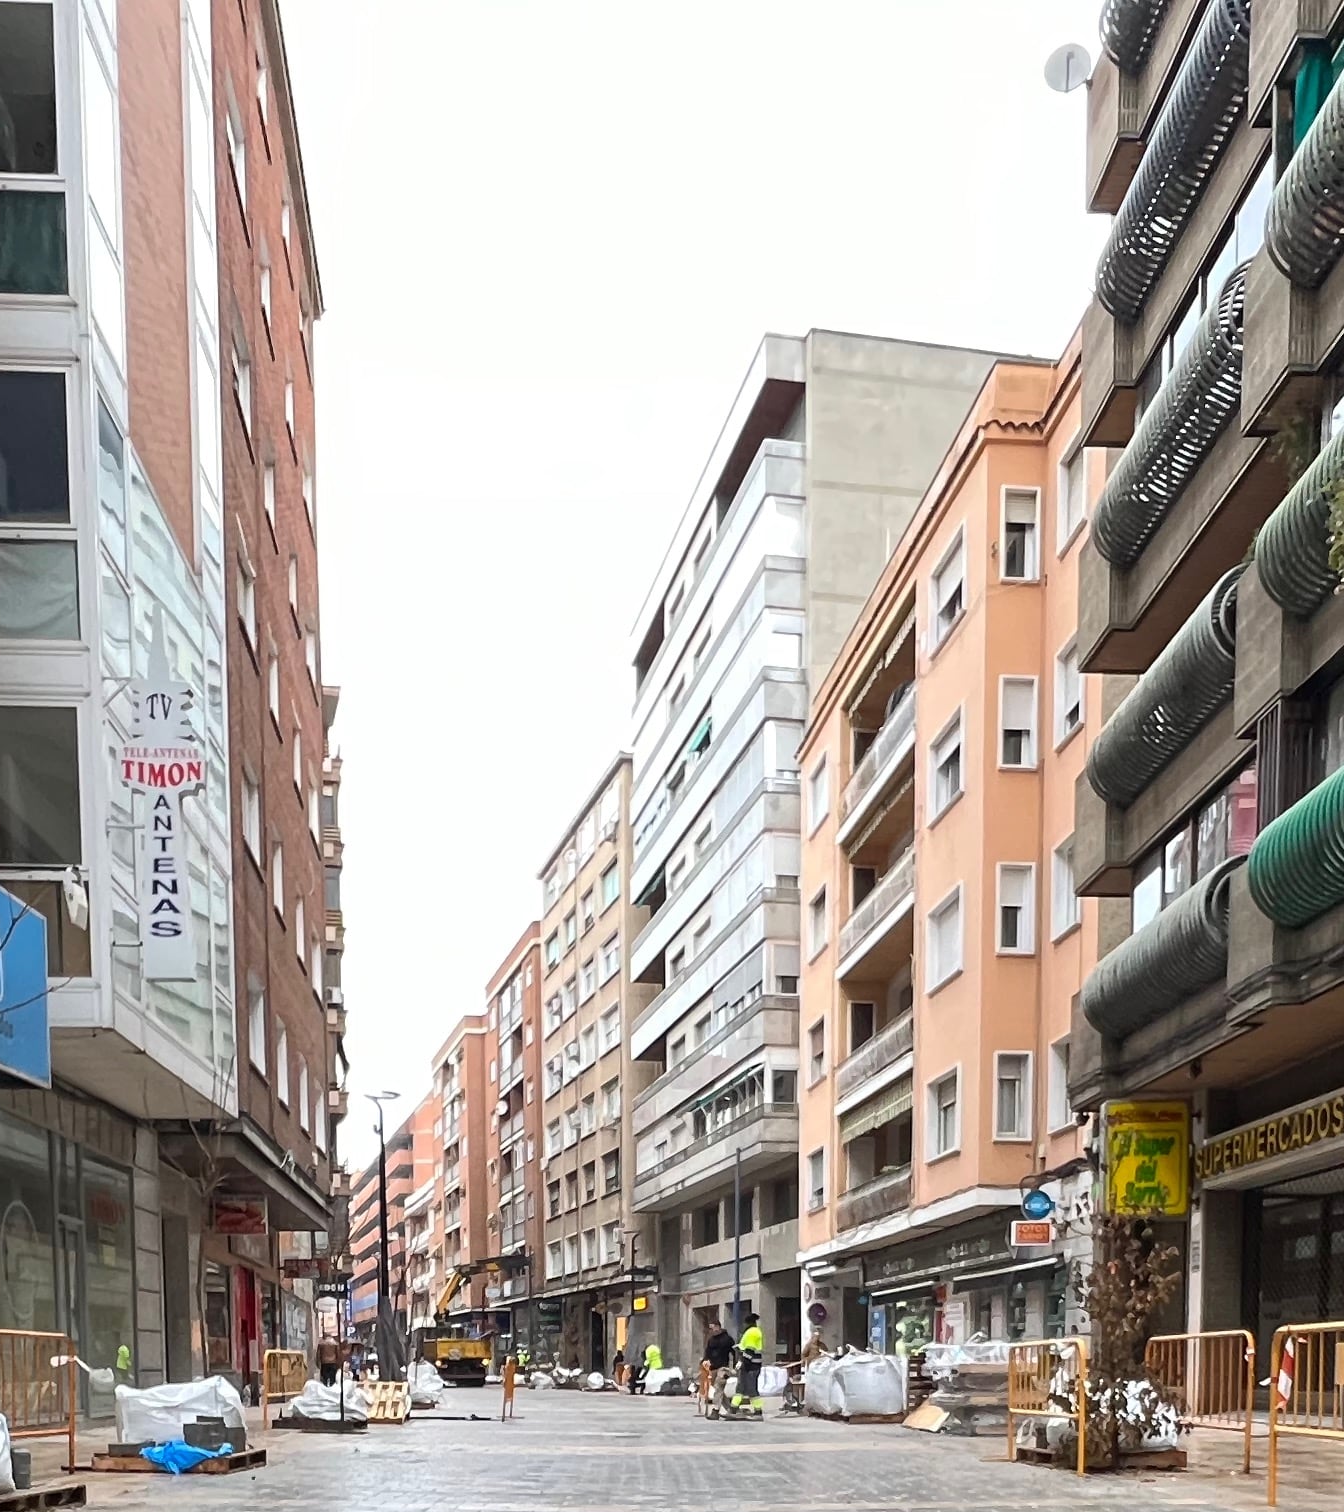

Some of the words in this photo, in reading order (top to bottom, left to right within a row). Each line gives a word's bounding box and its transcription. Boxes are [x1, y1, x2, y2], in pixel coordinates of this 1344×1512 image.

[145, 692, 173, 721] TV
[120, 758, 203, 789] TIMON
[149, 794, 184, 939] ANTENAS
